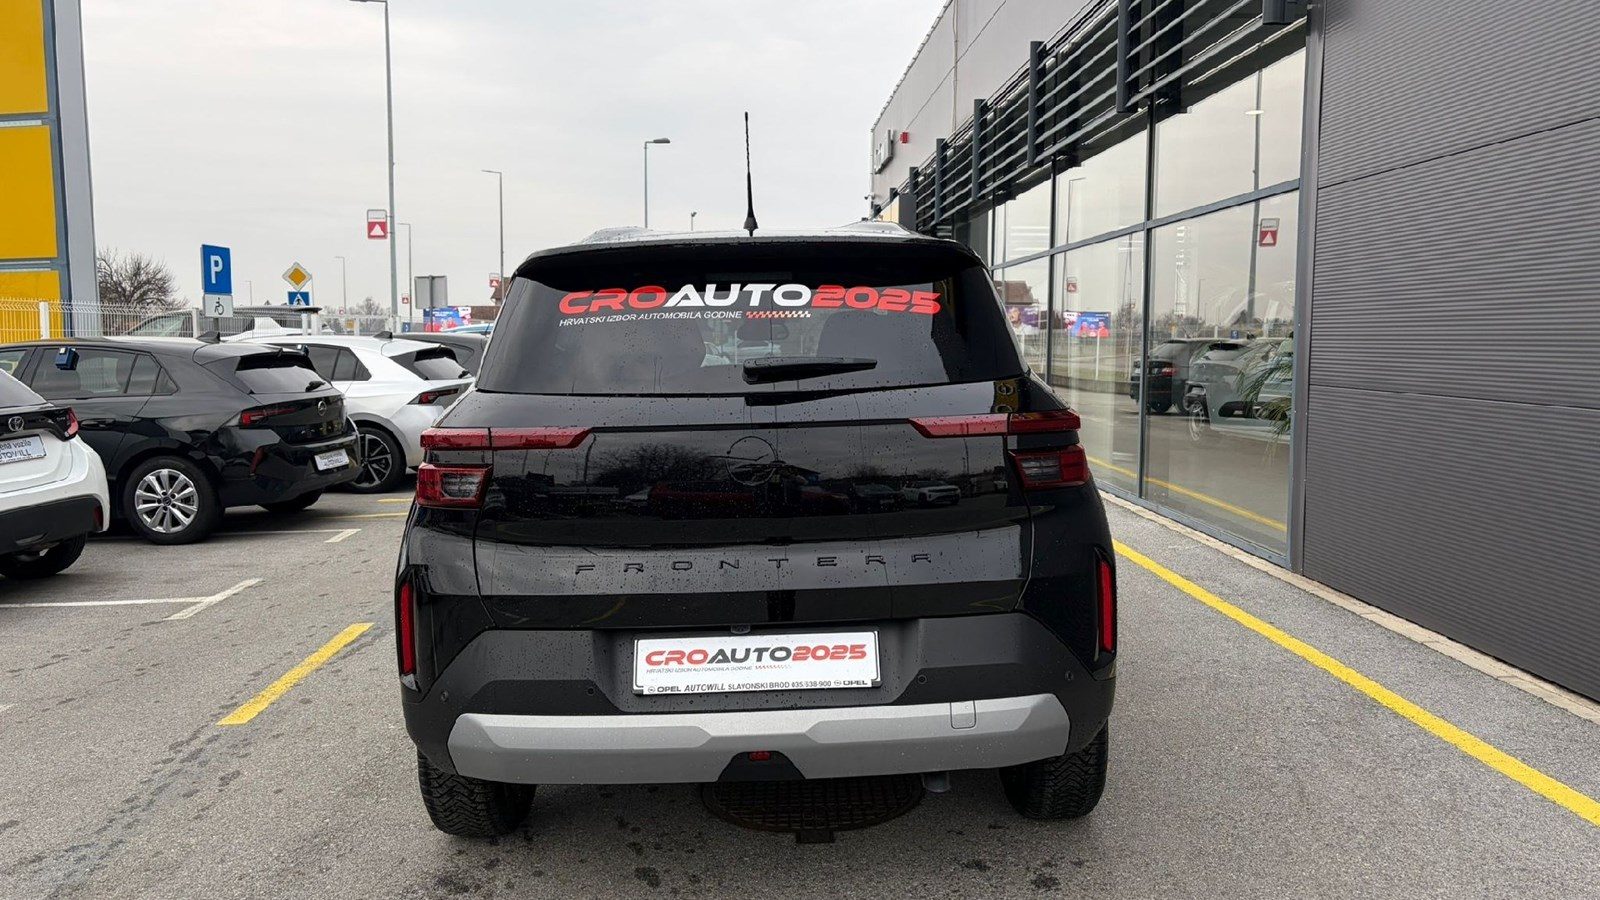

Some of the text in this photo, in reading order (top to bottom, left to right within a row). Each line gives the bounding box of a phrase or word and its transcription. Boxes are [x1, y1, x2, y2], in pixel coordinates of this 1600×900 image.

[210, 255, 223, 284] P
[559, 283, 941, 315] CROAUTO2025
[559, 311, 742, 327] HRVATSKI IZBOR AUTOMOBILA GODINE
[575, 554, 932, 574] FRONTERA
[645, 644, 867, 666] CROAUTO2025
[769, 681, 790, 689] BROD
